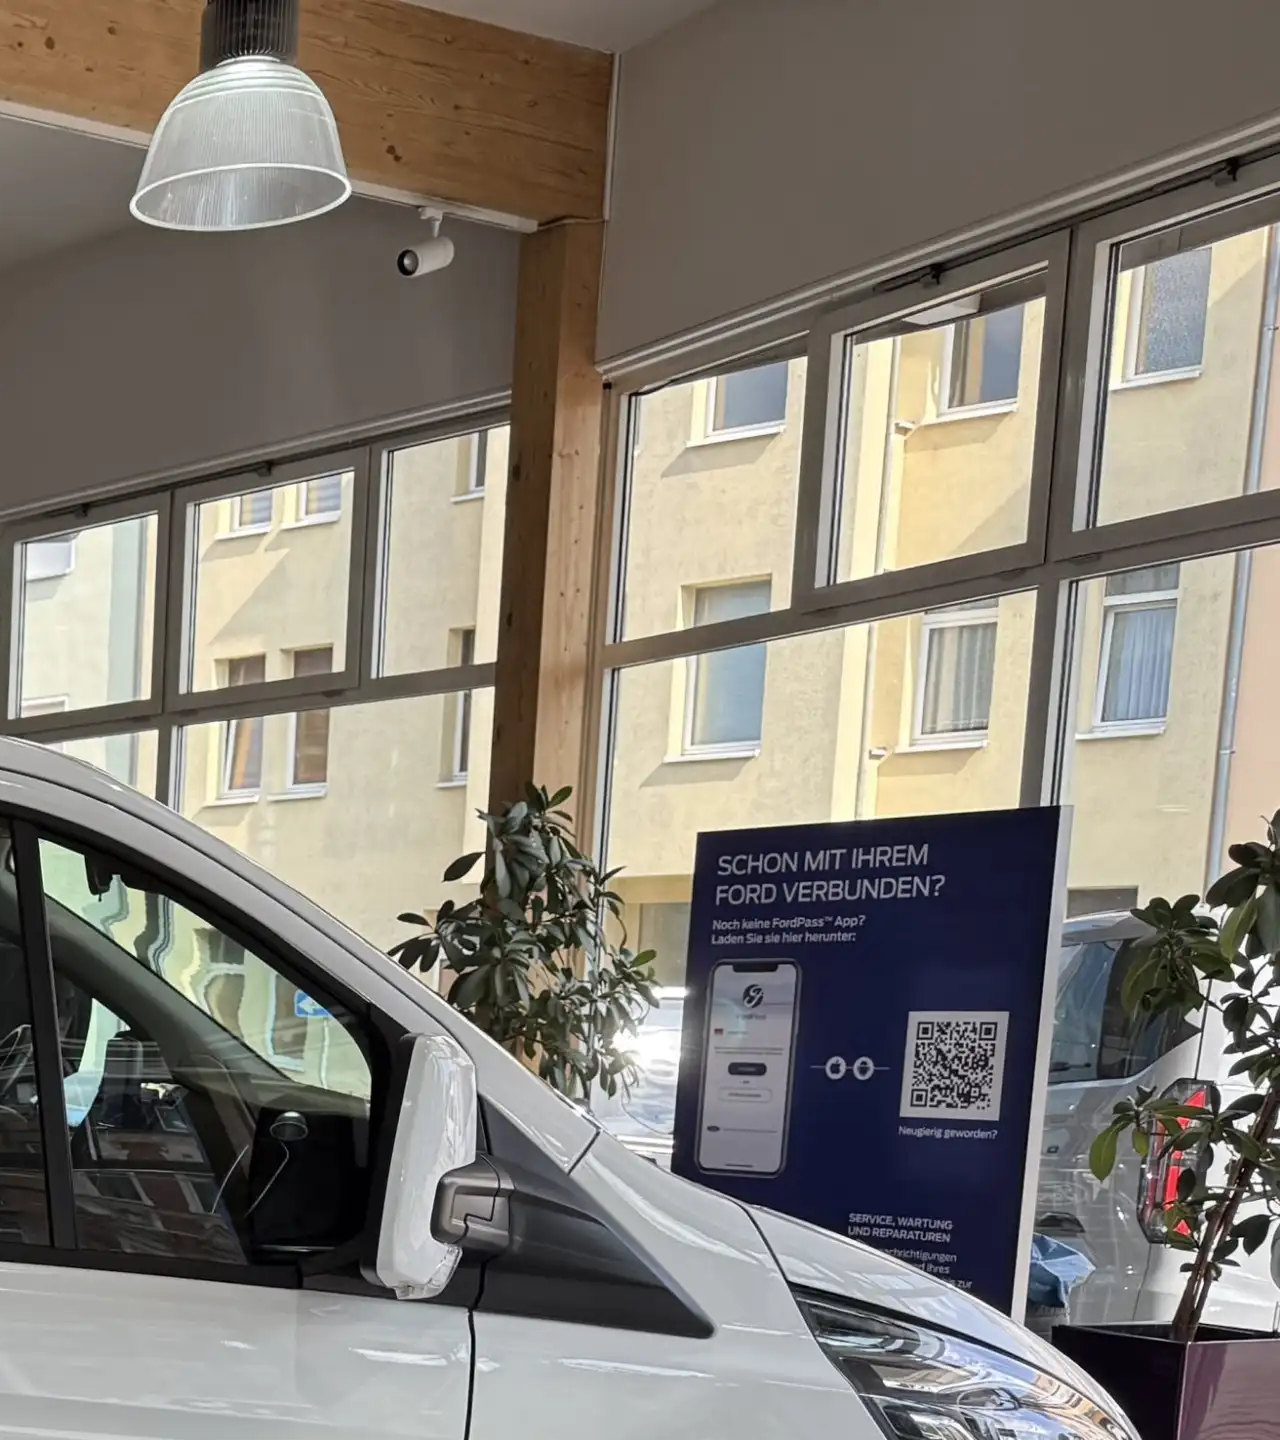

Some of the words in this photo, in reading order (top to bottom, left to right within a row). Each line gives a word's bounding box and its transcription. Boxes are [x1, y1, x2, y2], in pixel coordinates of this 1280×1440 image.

[717, 852, 799, 876] SCHON
[804, 849, 847, 872] MIT
[851, 843, 929, 869] IHREM
[715, 883, 777, 906] FORD
[782, 874, 946, 903] VERBUNDEN?
[712, 919, 740, 930] Noch
[741, 917, 770, 929] keine
[834, 914, 866, 929] App?
[711, 933, 744, 945] Laden
[745, 932, 763, 944] Sie
[764, 932, 780, 943] sie
[782, 931, 803, 943] hier
[804, 931, 856, 943] herunter:
[898, 1126, 943, 1139] Neugierig
[944, 1128, 998, 1140] geworden?
[848, 1213, 895, 1227] SERVICE,
[897, 1216, 953, 1231] WARTUNG
[848, 1225, 871, 1236] UND
[872, 1228, 951, 1243] REPARATUREN
